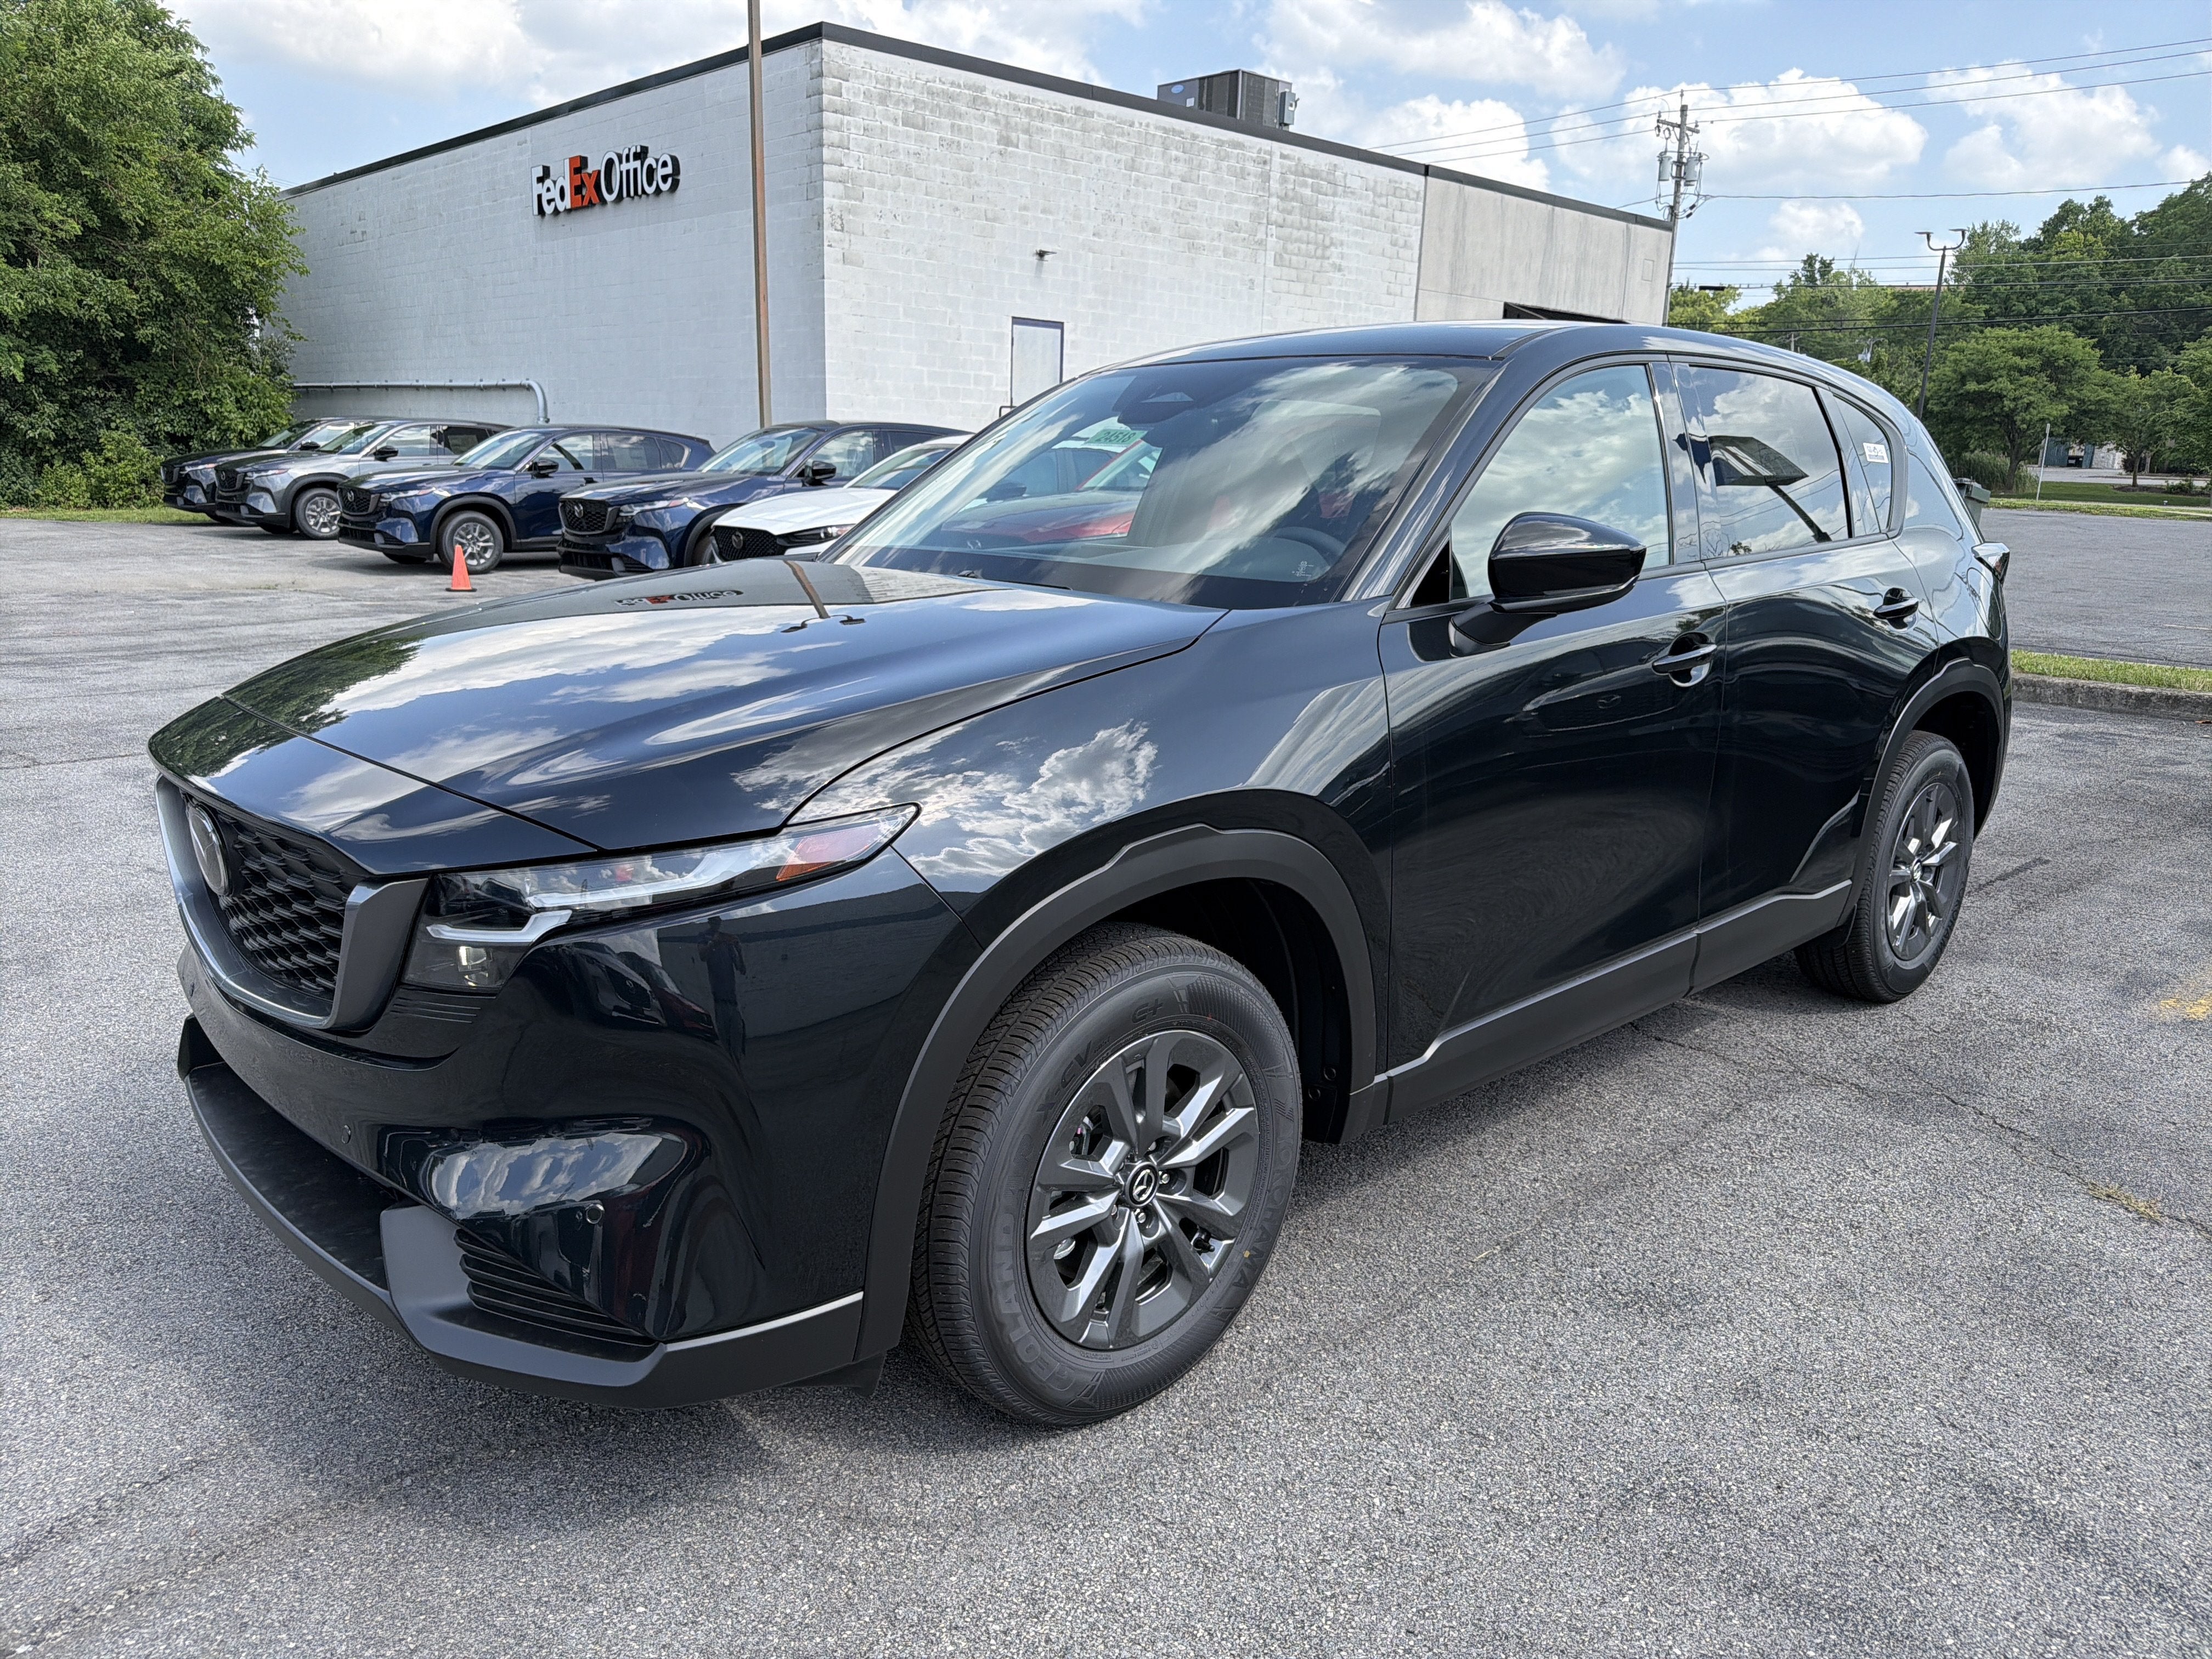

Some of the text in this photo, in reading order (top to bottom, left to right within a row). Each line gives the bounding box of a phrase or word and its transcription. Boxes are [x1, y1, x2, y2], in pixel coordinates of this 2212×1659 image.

[531, 145, 680, 216] FedEx Office
[1232, 1125, 1294, 1289] YOKOHAMA
